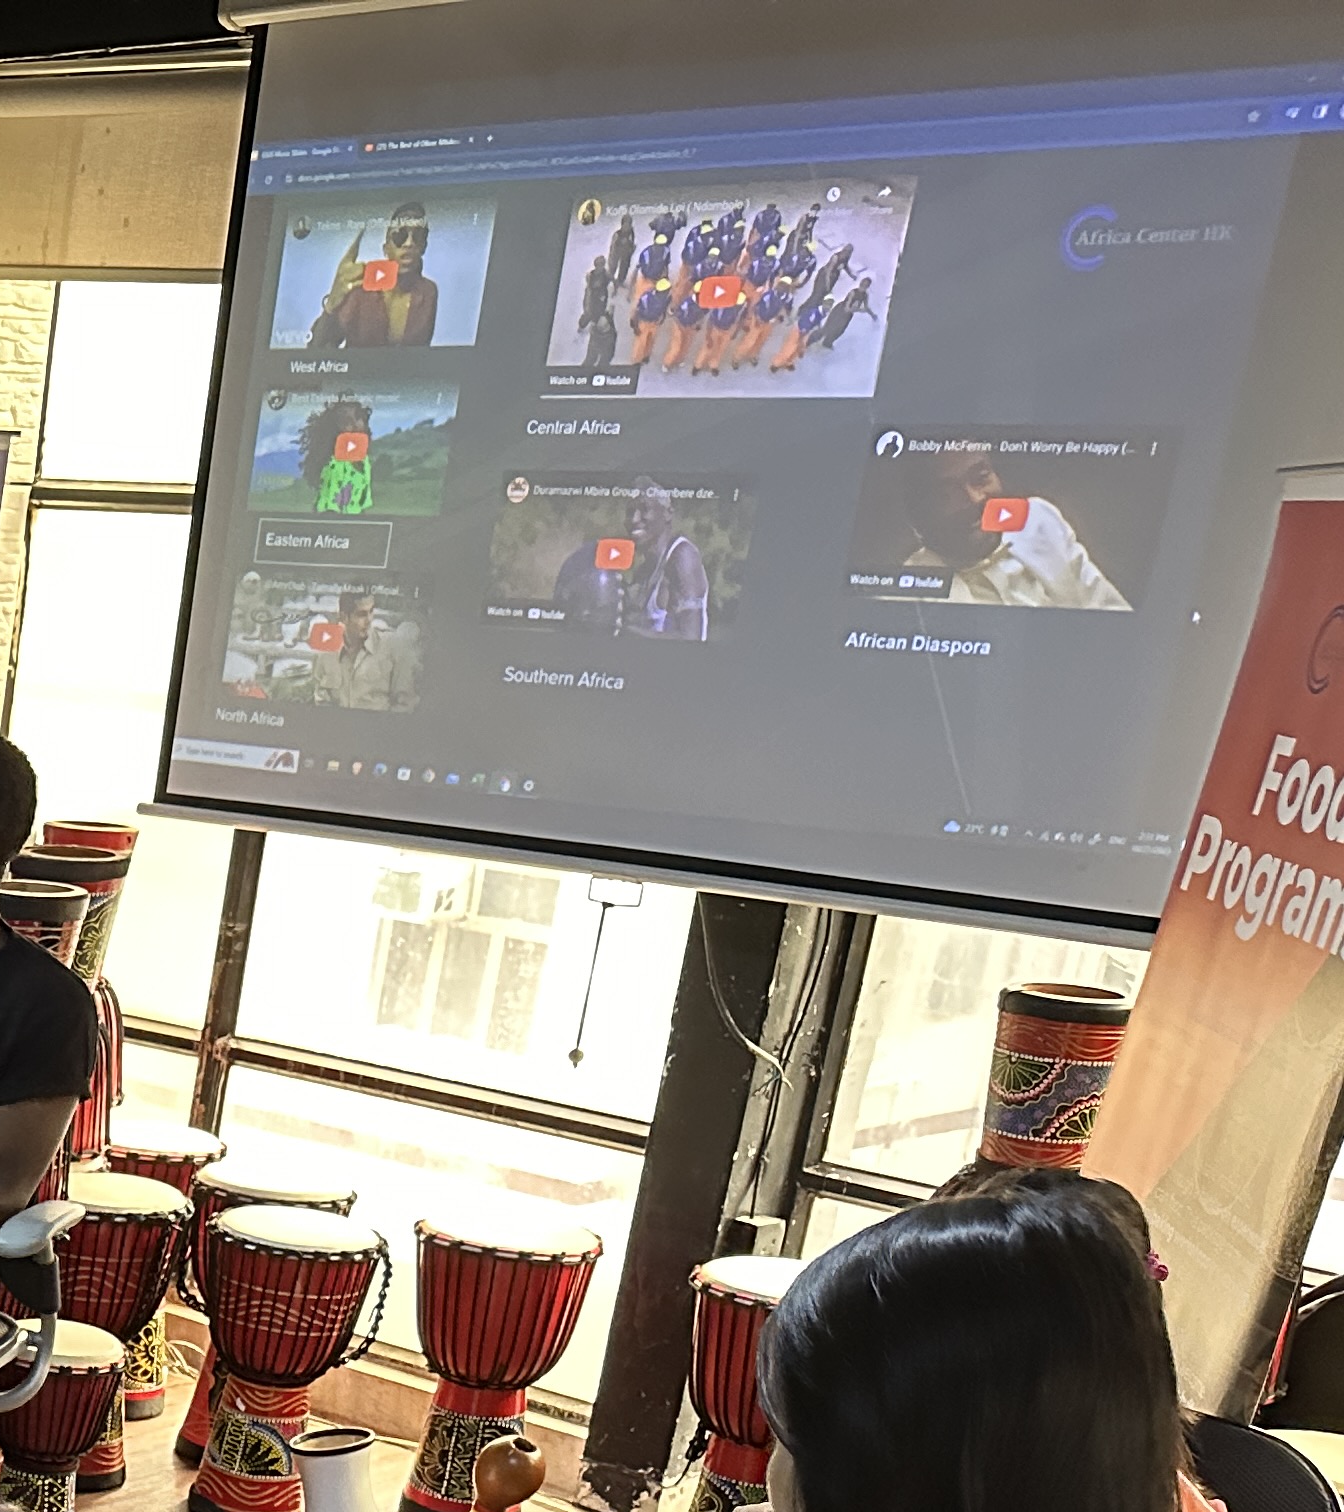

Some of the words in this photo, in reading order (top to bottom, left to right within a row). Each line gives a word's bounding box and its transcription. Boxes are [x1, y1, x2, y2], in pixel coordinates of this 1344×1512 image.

[1075, 229, 1131, 246] Africa
[1135, 228, 1198, 245] Center
[1203, 225, 1233, 242] HK
[290, 361, 316, 374] West
[318, 361, 349, 374] Africa
[549, 376, 574, 387] Watch
[526, 419, 576, 436] Central
[579, 420, 621, 436] Africa
[908, 440, 941, 454] Bobby
[1030, 441, 1063, 455] Worry
[1067, 442, 1080, 454] Be
[1082, 442, 1120, 456] Happy
[612, 486, 640, 500] Group
[265, 532, 312, 548] Eastern
[314, 534, 350, 550] Africa
[850, 574, 879, 586] Watch
[845, 632, 907, 652] African
[911, 634, 991, 657] Diaspora
[503, 666, 574, 687] Southern
[578, 671, 624, 690] Africa
[216, 707, 247, 724] North
[250, 710, 285, 728] Africa
[1179, 814, 1344, 961] Program
